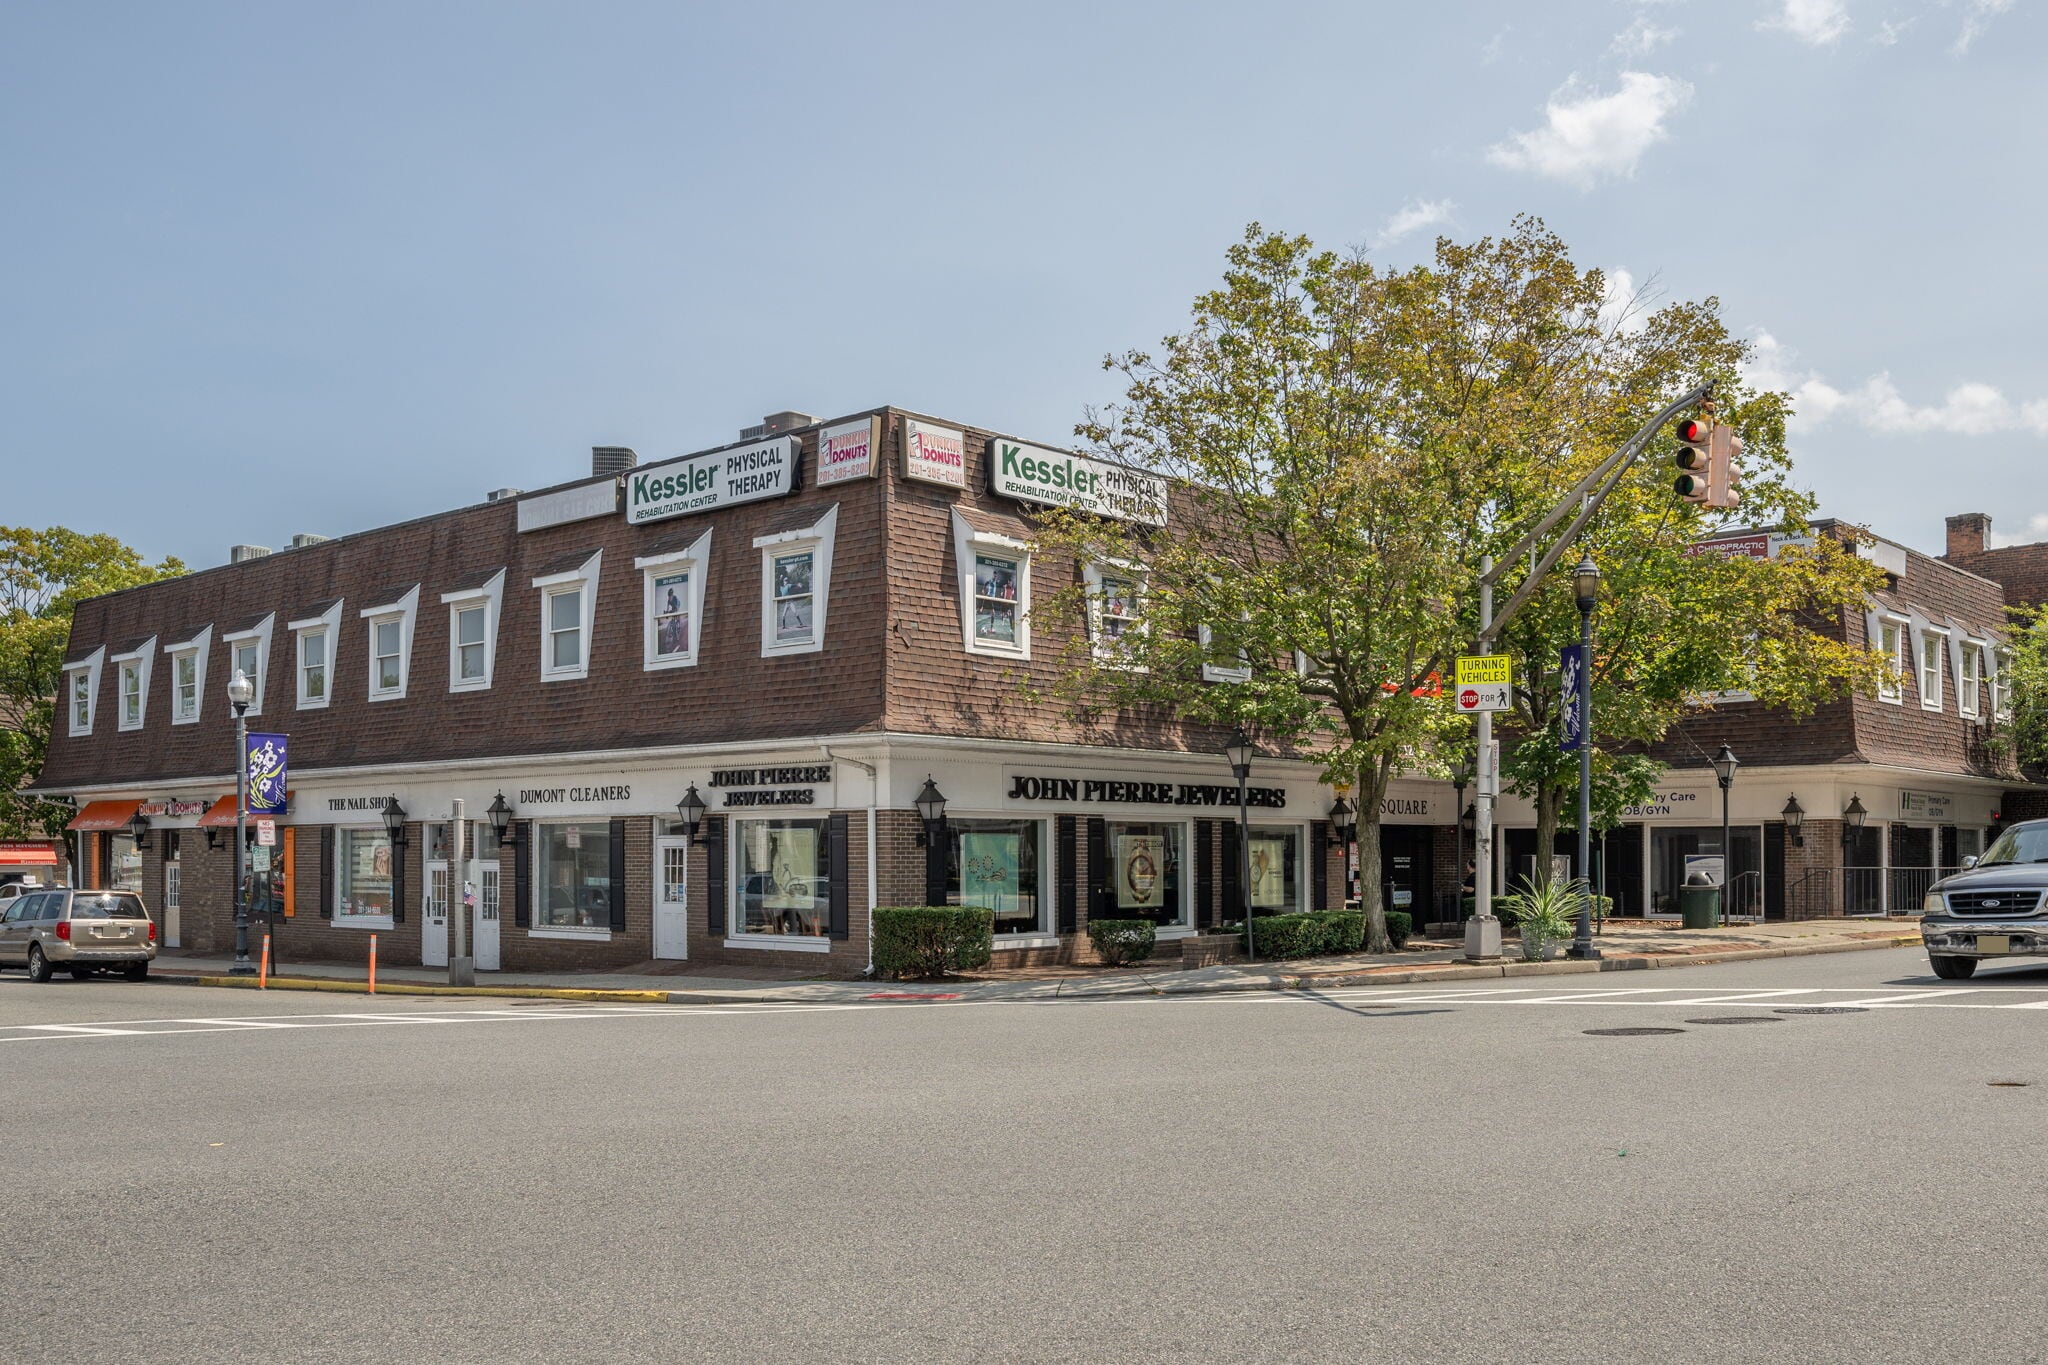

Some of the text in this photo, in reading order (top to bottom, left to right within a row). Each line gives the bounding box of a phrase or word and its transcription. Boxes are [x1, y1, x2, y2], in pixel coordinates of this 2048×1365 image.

[726, 446, 783, 475] PHYSICAL
[833, 444, 867, 464] DONUTS
[923, 447, 961, 467] DONUTS
[1001, 443, 1098, 494] Kessler
[633, 463, 719, 505] Kessler
[728, 470, 781, 497] THERAPY
[1106, 471, 1159, 498] PHYSICAL
[1005, 481, 1098, 510] REHABILITATION CENTER
[635, 493, 717, 520] REHABILITATION CENTER
[1461, 659, 1505, 671] TURNING
[1460, 670, 1506, 683] VEHICLES
[1461, 694, 1495, 704] STOP FOR
[708, 766, 831, 788] JOHN PIERRE
[275, 771, 287, 806] Welcome
[520, 785, 631, 804] DUMONT CLEANERS
[723, 789, 814, 807] JEWELERS
[1008, 776, 1287, 809] JOHN PIERRE JEWELERS
[1670, 792, 1696, 801] Care
[174, 801, 202, 815] DONUTS
[328, 798, 346, 811] THE
[347, 797, 368, 810] NAIL
[1380, 799, 1428, 815] SQUARE
[1624, 805, 1670, 816] OB/GYN
